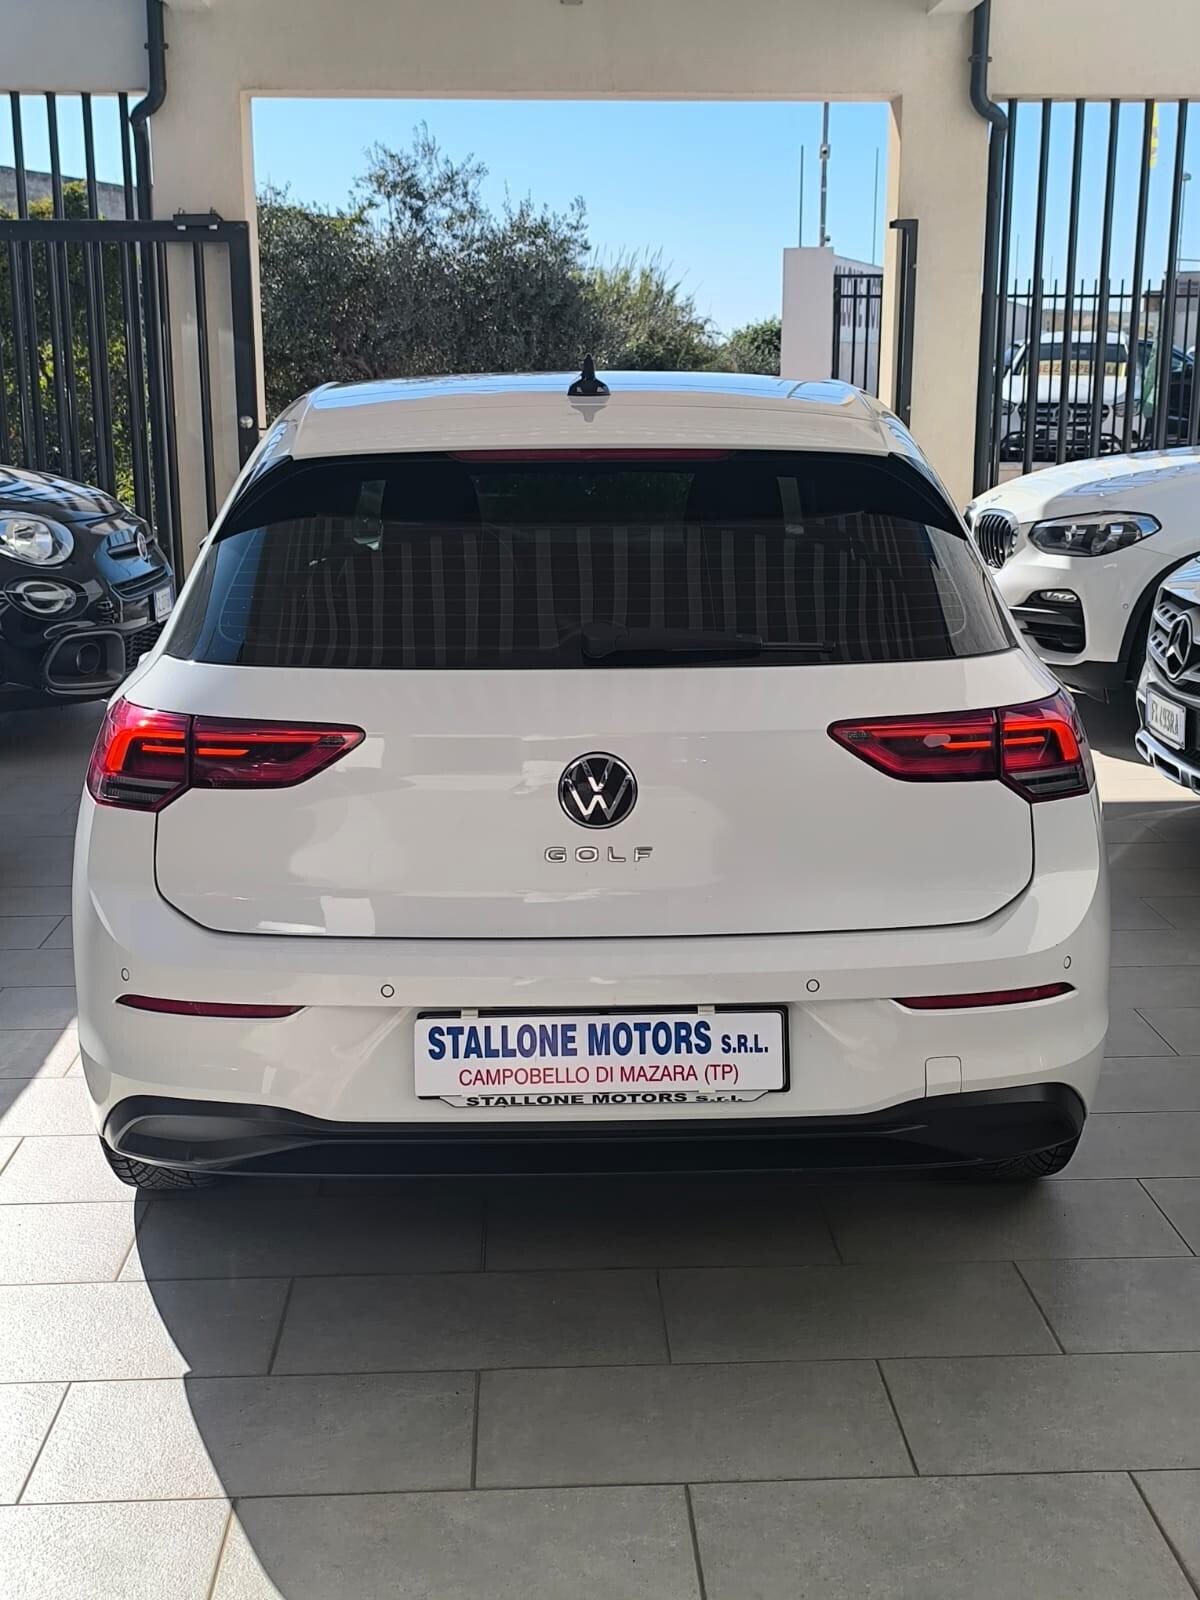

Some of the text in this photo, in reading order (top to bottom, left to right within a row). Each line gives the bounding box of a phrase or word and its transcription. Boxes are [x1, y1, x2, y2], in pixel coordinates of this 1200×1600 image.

[544, 846, 653, 863] GOLF
[428, 1021, 769, 1060] STALLONE MOTORS S.R.L.
[459, 1064, 739, 1086] CAMPOBELLO DI MAZARA (TP)
[466, 1095, 584, 1106] STALLONE
[592, 1093, 688, 1104] MOTORS
